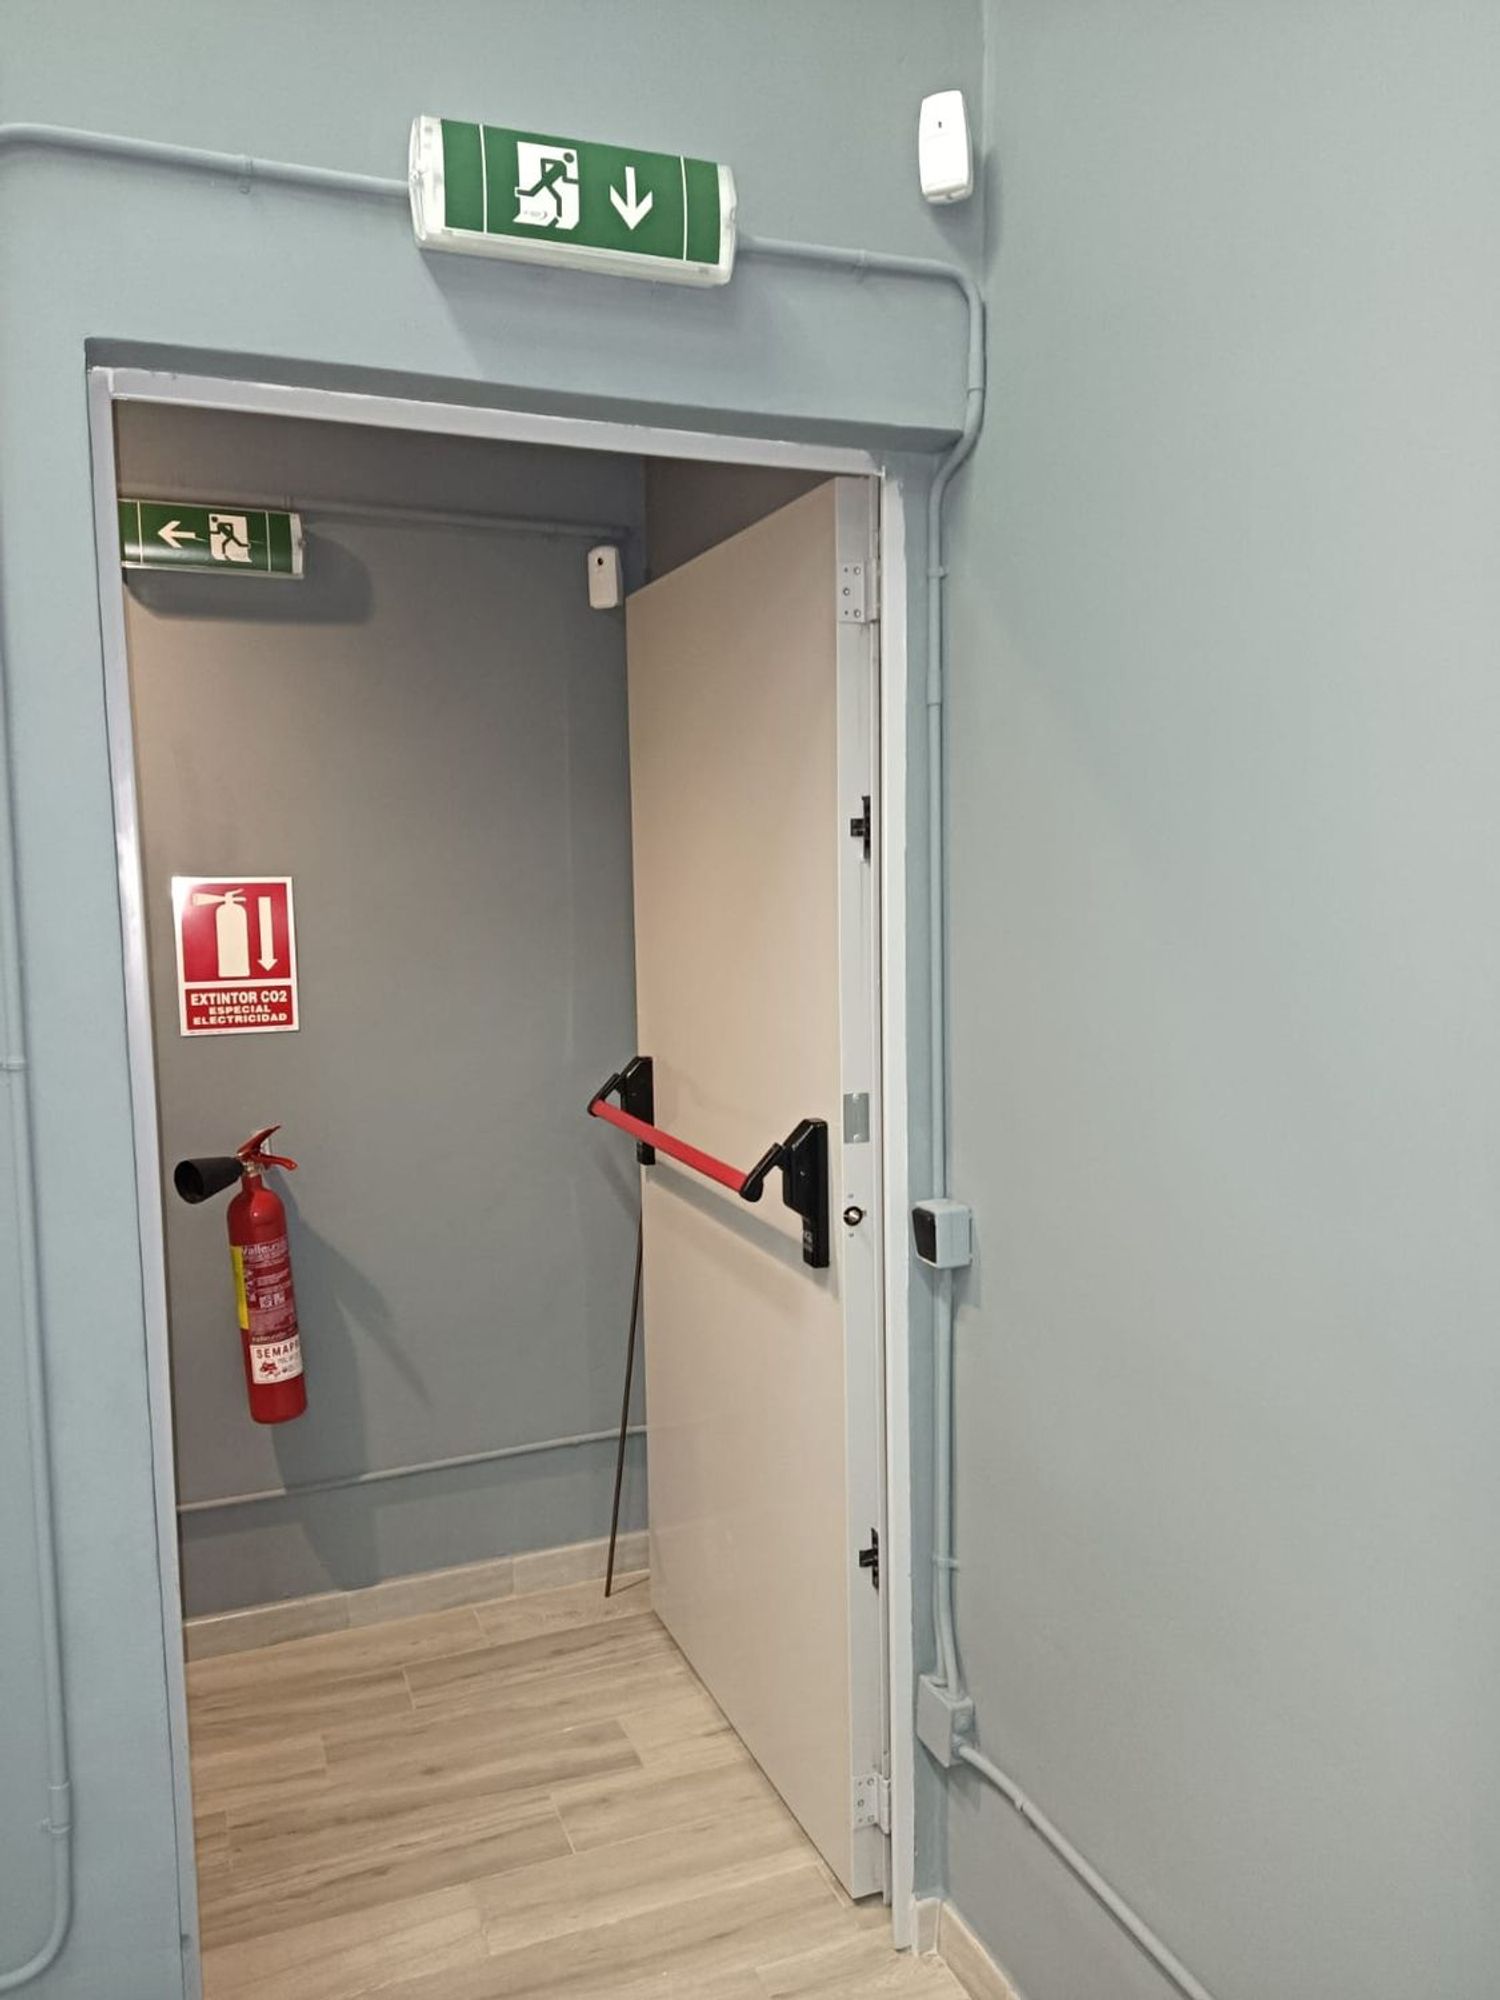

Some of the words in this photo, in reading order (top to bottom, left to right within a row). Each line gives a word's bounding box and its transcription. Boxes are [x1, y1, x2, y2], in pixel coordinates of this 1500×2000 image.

[190, 992, 258, 1006] EXTINTOR
[260, 990, 288, 1003] CO2
[208, 1004, 271, 1015] ESPECIAL
[193, 1013, 288, 1025] ELECTRICIDAD
